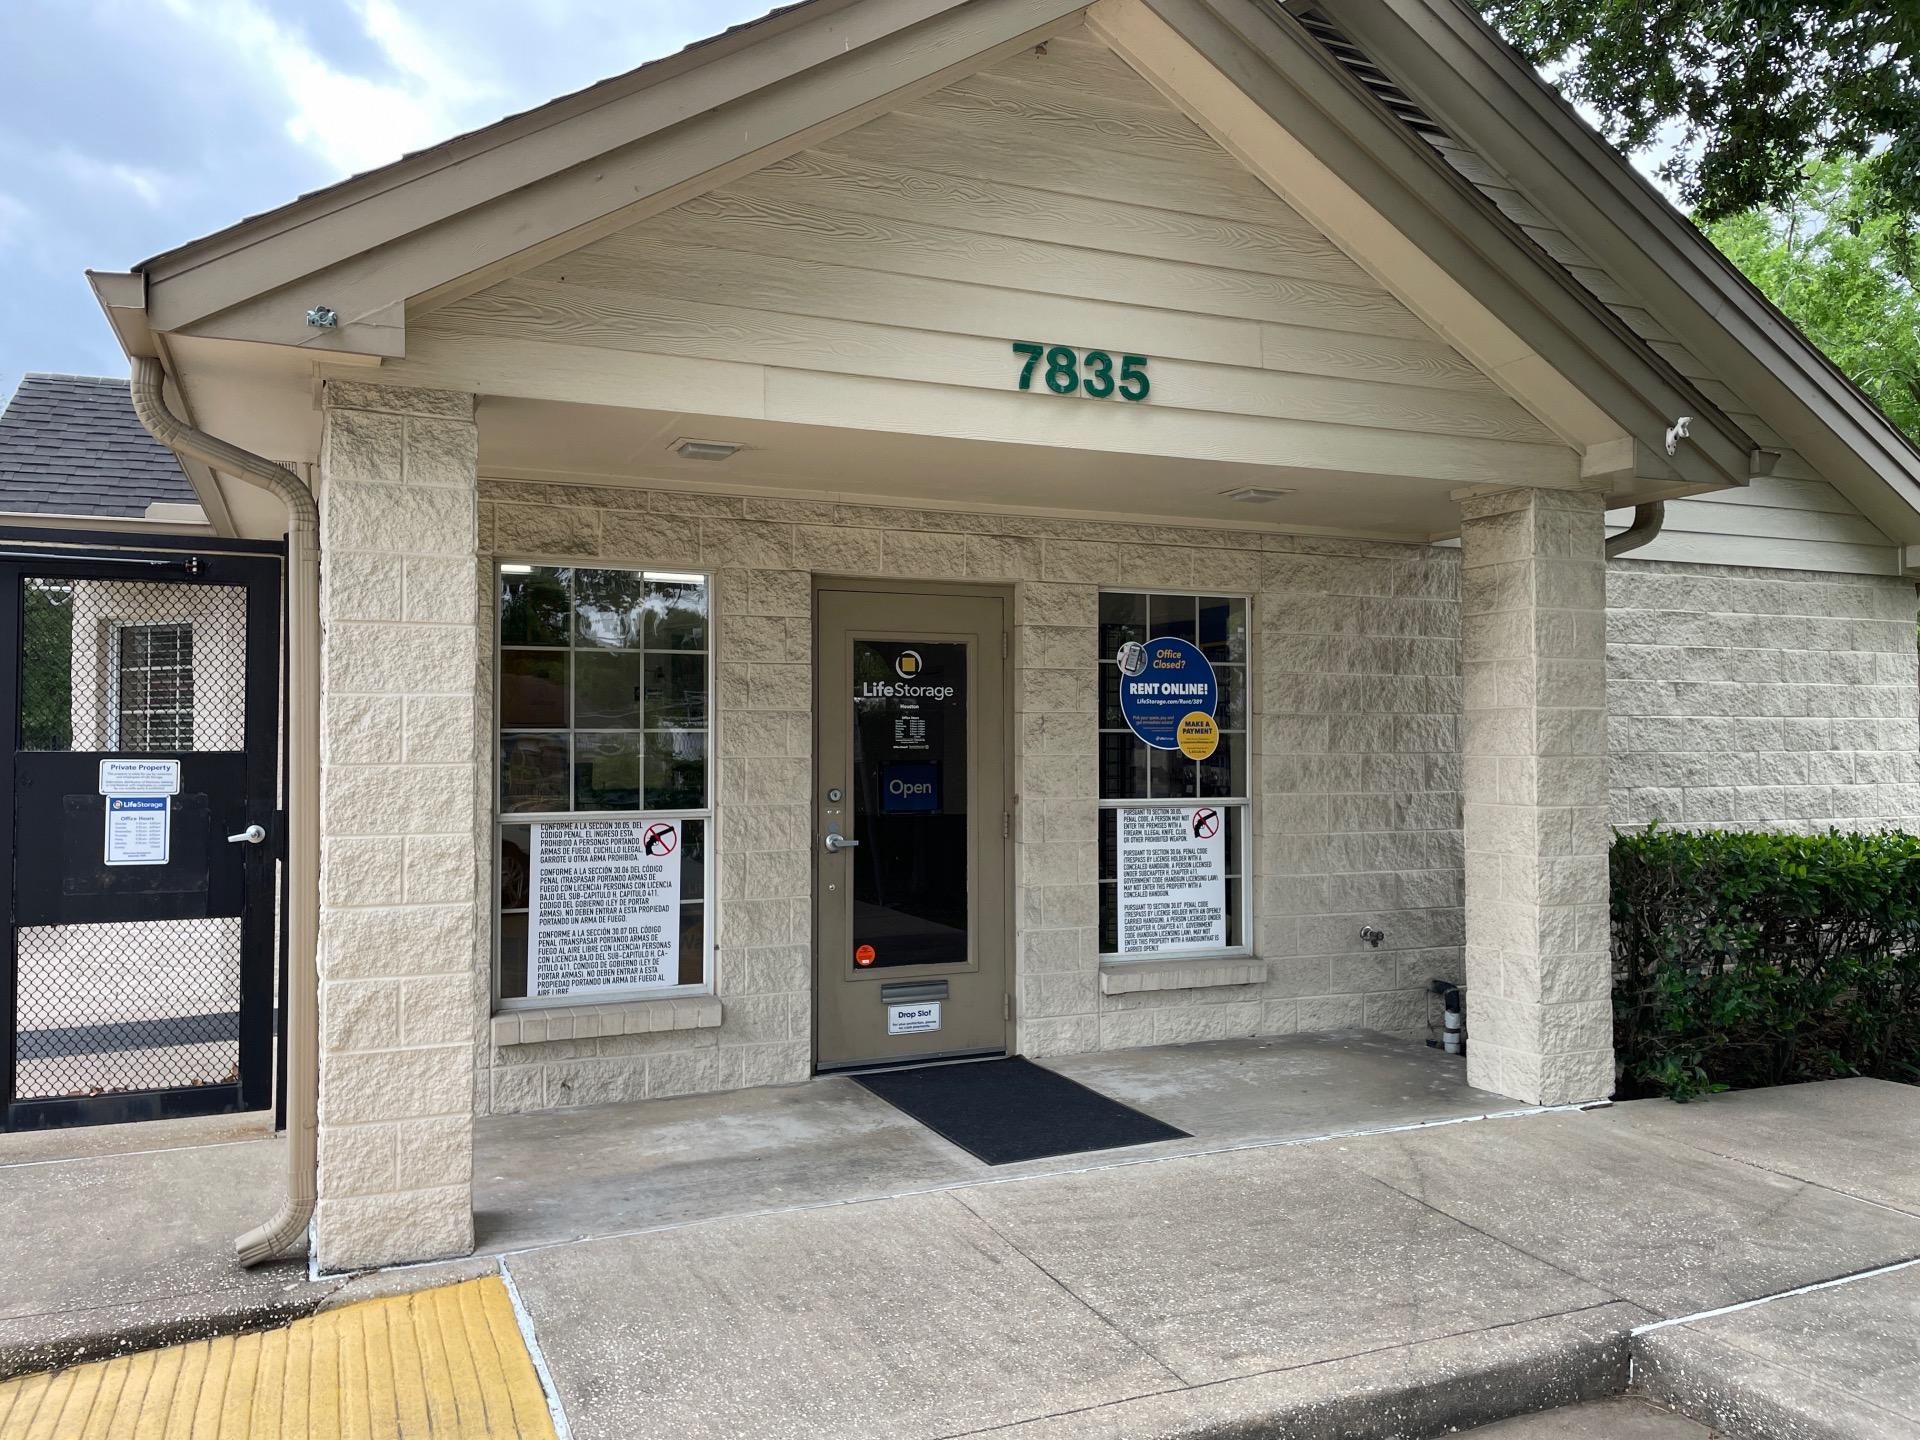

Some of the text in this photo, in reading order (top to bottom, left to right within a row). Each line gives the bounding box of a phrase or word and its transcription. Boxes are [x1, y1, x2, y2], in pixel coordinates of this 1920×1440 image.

[1013, 342, 1150, 401] 7835
[1156, 649, 1182, 659] Office
[1153, 659, 1185, 669] Closed?
[863, 681, 954, 701] LifeStorage
[1129, 682, 1208, 695] RENT ONLINE!
[1182, 727, 1213, 735] PAYMENT
[138, 764, 171, 772] Property
[889, 779, 932, 798] Open
[540, 868, 572, 876] CONFORME
[647, 881, 672, 889] LICENCIA
[568, 891, 611, 899] SUB-CAPITULO
[619, 890, 647, 898] CAPITULO
[575, 900, 604, 908] GOBIERNO
[628, 898, 650, 906] PORTAR
[575, 908, 594, 916] DEBEN
[595, 907, 618, 915] ENTRAR
[538, 930, 570, 938] CONFORME
[599, 936, 629, 944] PORTANDO
[538, 947, 557, 955] FUEGO
[582, 945, 599, 953] LIBRE
[641, 942, 671, 950] PERSONAS
[607, 951, 649, 960] SUB-CAPITULO
[609, 960, 638, 968] GOBIERNO
[537, 972, 560, 980] PORTAR
[596, 969, 615, 977] DEBEN
[616, 968, 638, 976] ENTRAR
[537, 980, 571, 988] PROPIEDAD
[571, 978, 601, 986] PORTANDO
[612, 976, 629, 984] ARMA
[638, 975, 657, 983] FUEGO
[898, 1011, 916, 1019] Drop
